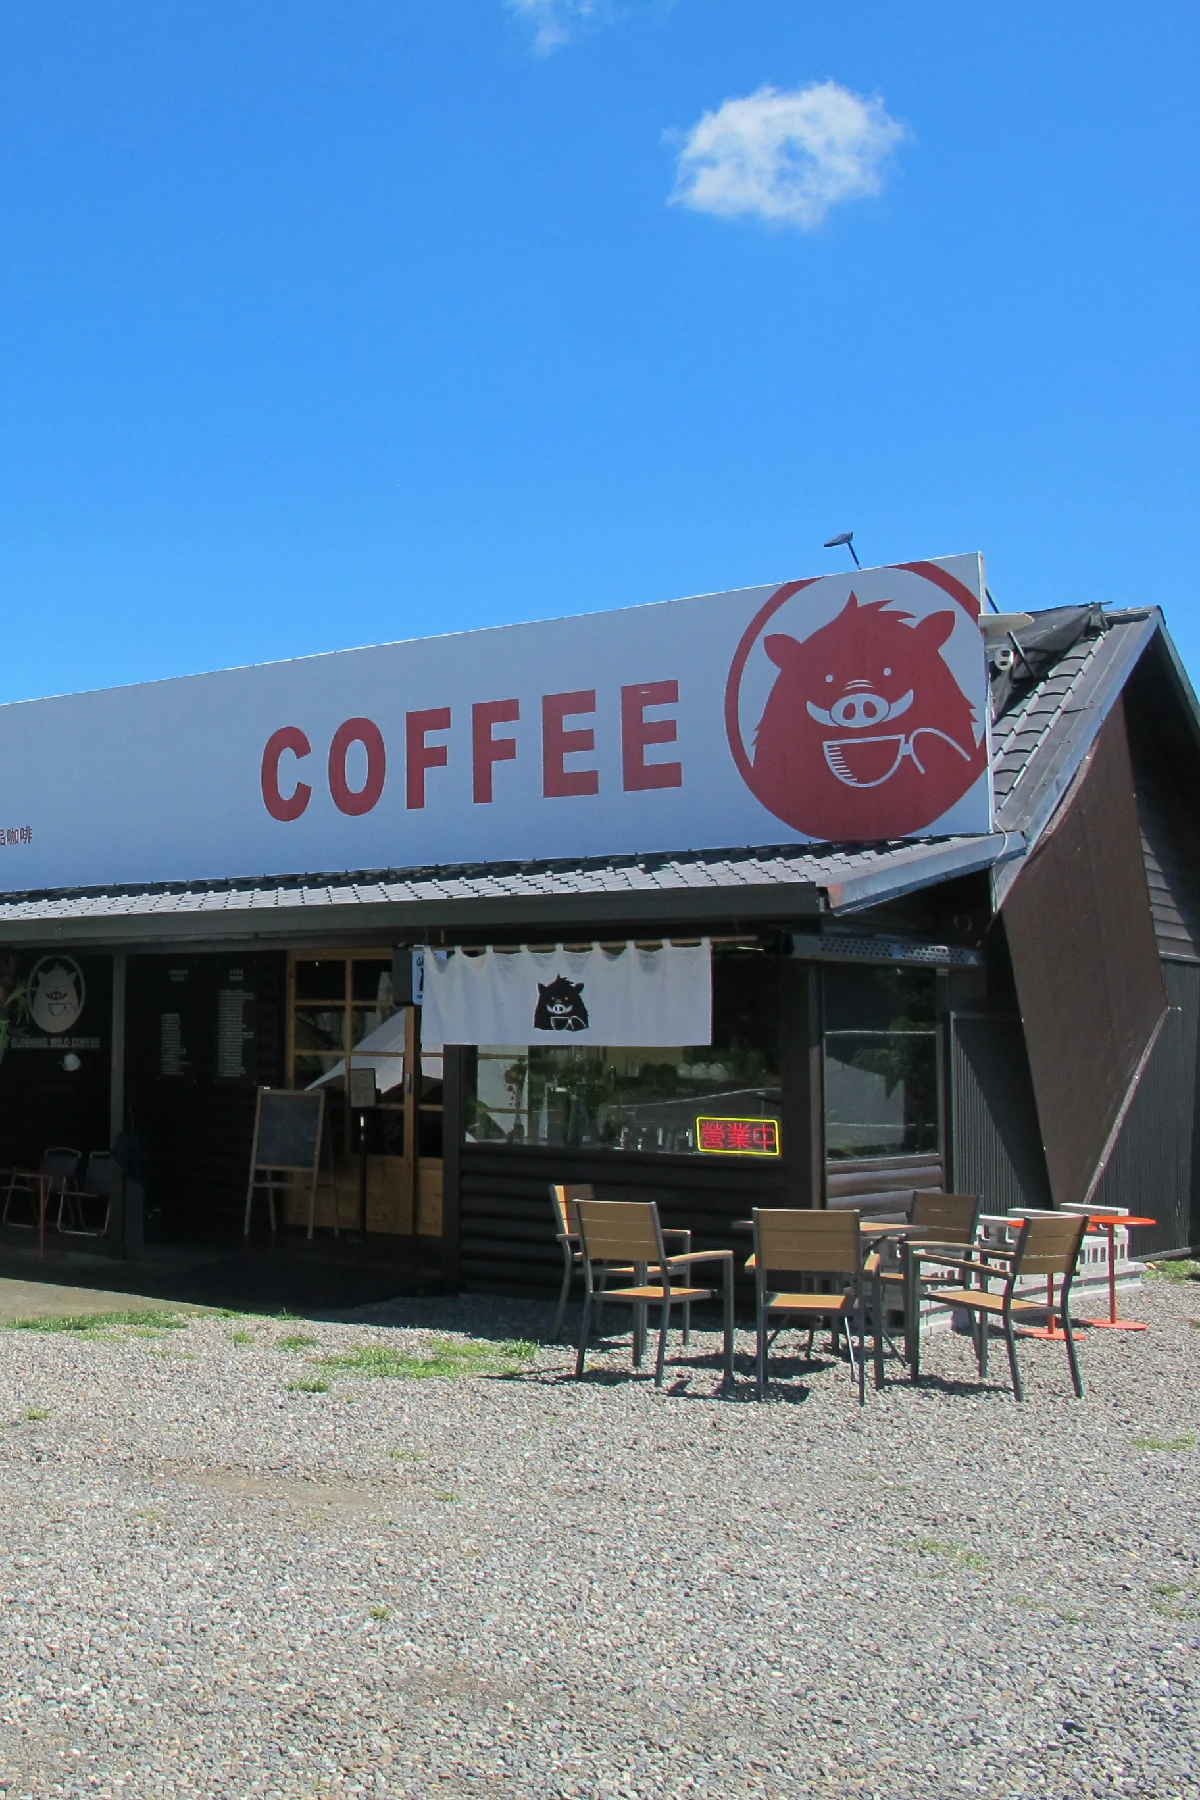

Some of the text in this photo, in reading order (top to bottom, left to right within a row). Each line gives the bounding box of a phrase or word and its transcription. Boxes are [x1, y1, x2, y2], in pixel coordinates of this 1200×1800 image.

[260, 678, 683, 823] COFFEE
[50, 1037, 70, 1049] WILD
[72, 1037, 101, 1049] COFFEE
[702, 1123, 775, 1151] 營業中
